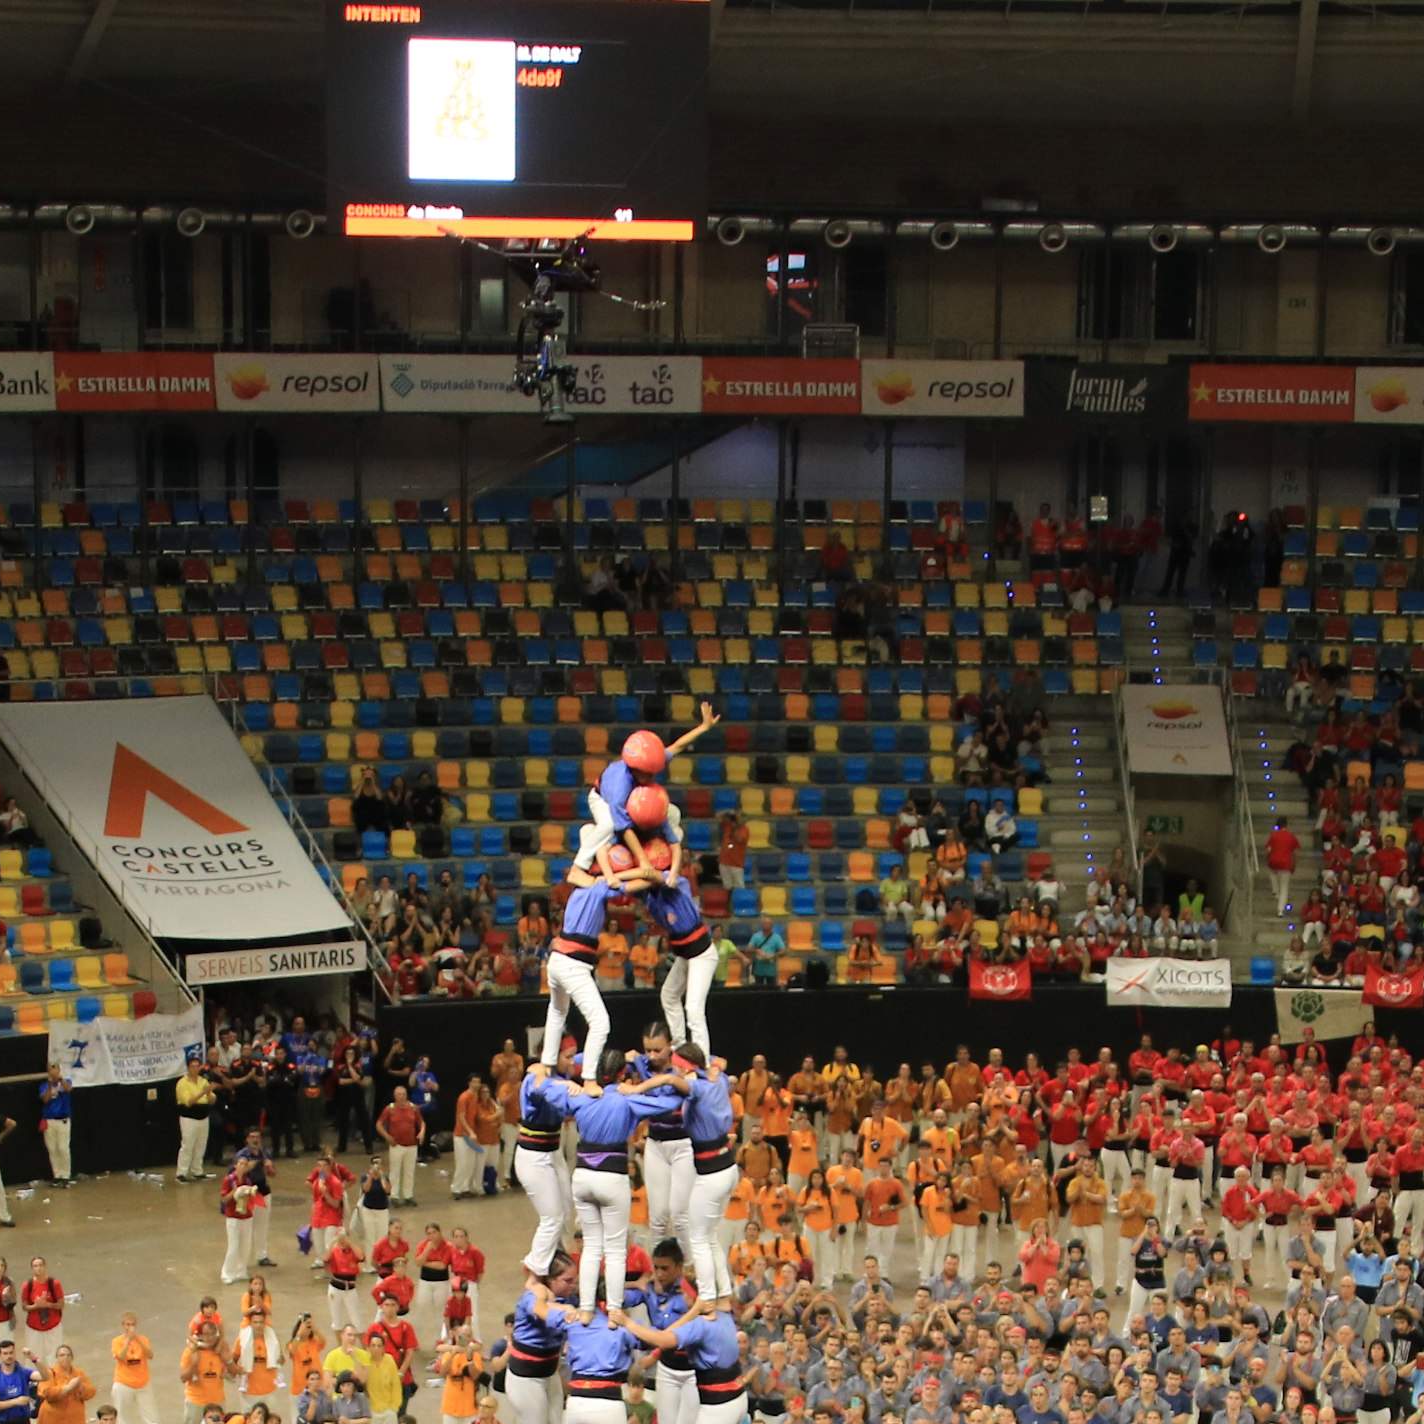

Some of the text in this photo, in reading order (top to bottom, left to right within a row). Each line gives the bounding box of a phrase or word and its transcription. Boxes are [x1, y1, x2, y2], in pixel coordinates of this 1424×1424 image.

[345, 5, 421, 24] INTENTEN
[517, 69, 562, 87] 4de9f
[346, 204, 405, 217] CONCURS
[78, 376, 211, 393] ESTRELLA DAMM
[282, 371, 369, 398] repsol
[629, 380, 674, 405] tac
[725, 381, 857, 398] ESTRELLA DAMM
[927, 377, 1014, 402] repsol
[1216, 388, 1350, 406] ESTRELLA DAMM
[1146, 720, 1203, 731] repsol
[111, 838, 264, 859] CONCURS
[122, 855, 275, 875] CASTELLS
[136, 879, 292, 896] TARRAGONA
[198, 948, 355, 978] SERVEIS SANITARIS
[1156, 967, 1225, 986] XICOTS
